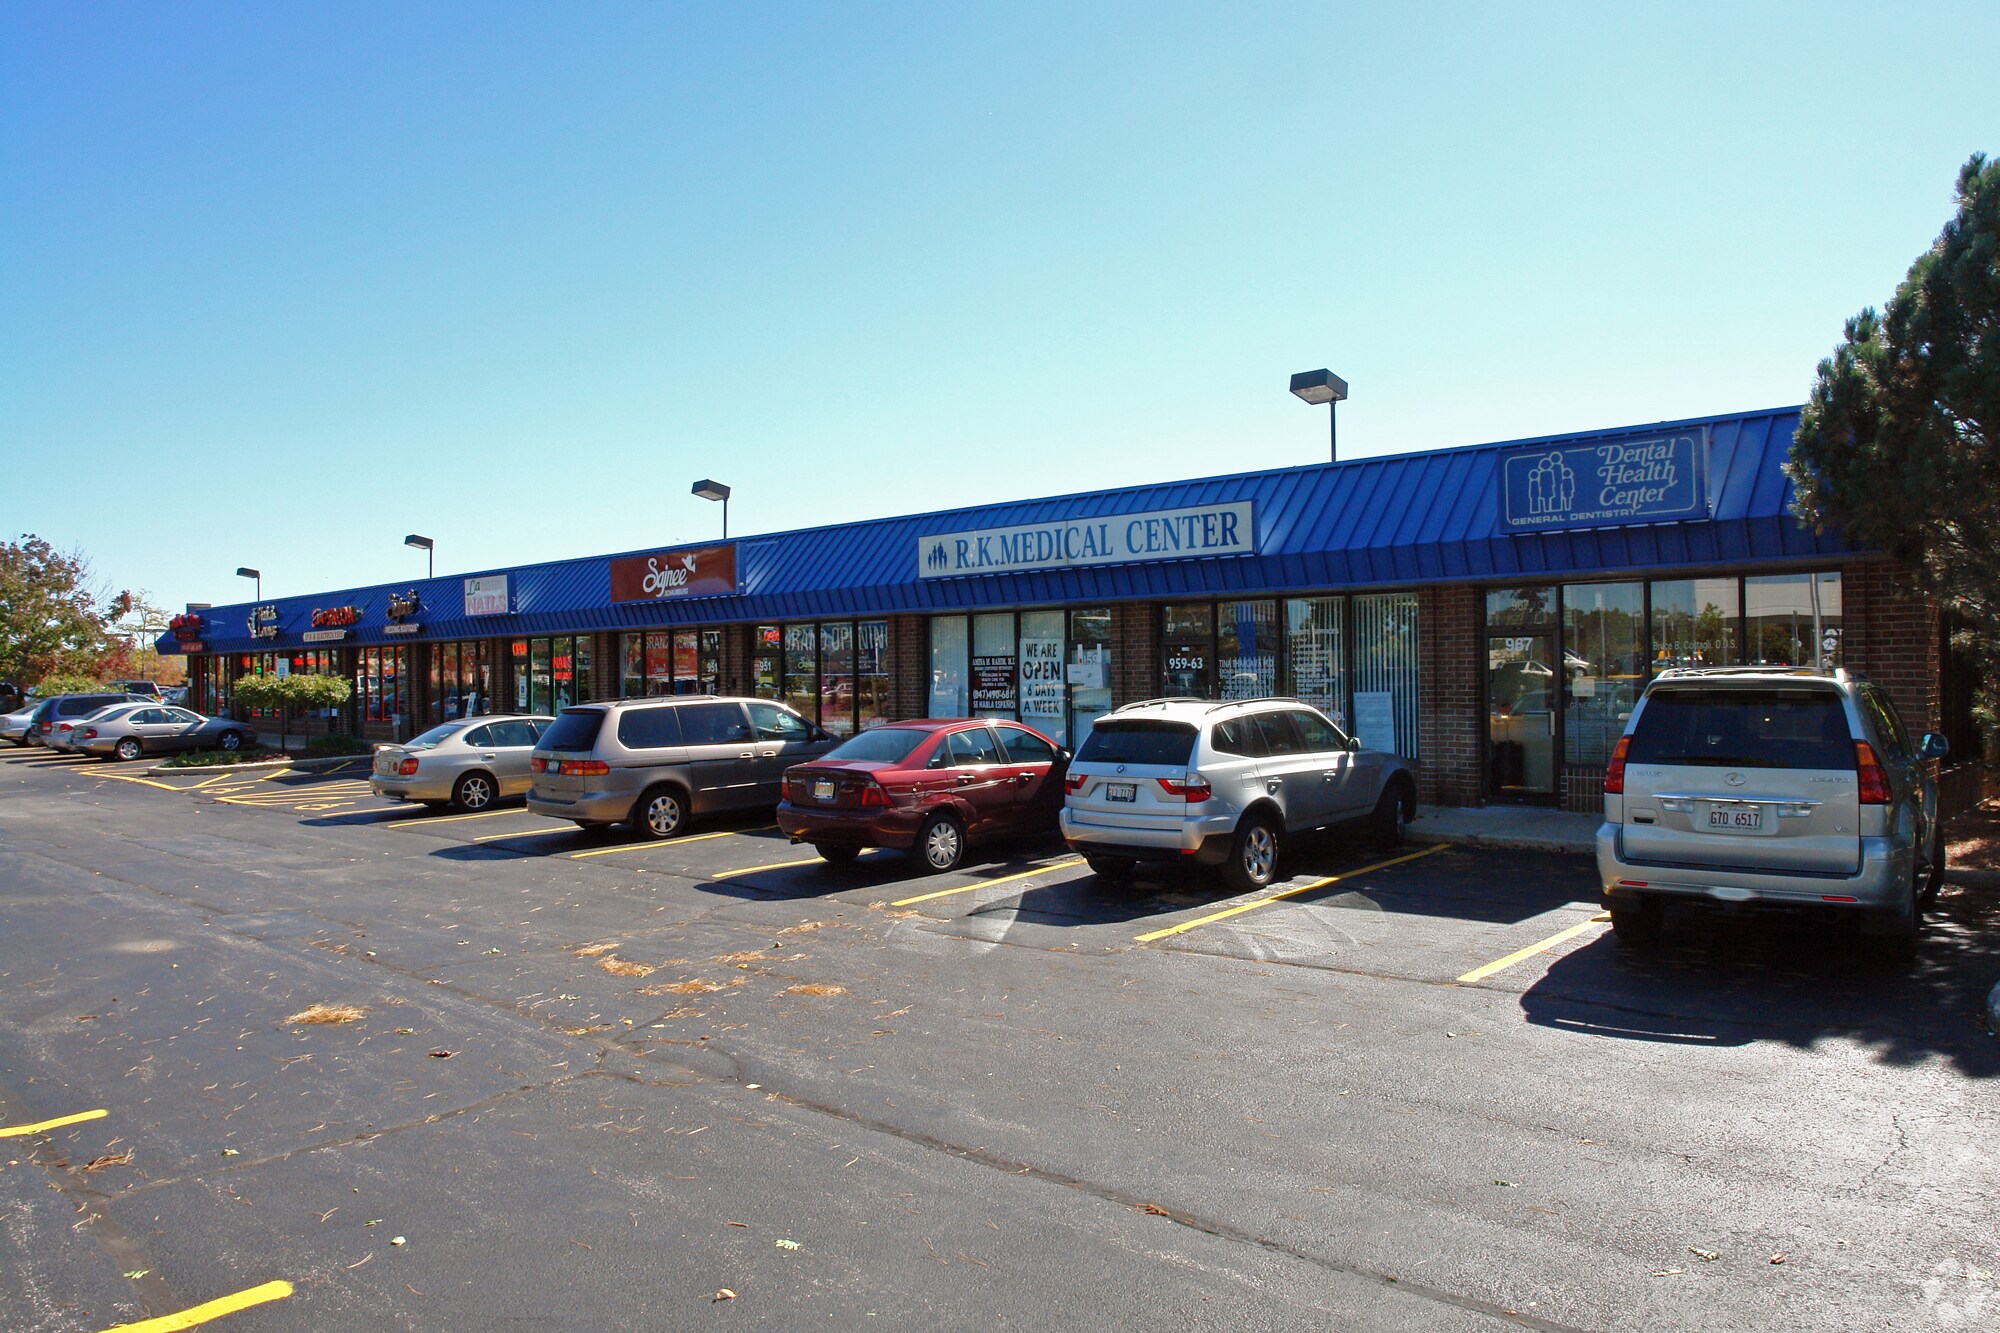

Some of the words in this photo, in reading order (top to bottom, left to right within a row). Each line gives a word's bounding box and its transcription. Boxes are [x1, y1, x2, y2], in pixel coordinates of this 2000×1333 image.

[1597, 438, 1676, 467] Dental
[1597, 459, 1678, 486] Health
[1600, 484, 1668, 510] Center
[1511, 514, 1566, 526] GENERAL
[1570, 509, 1636, 521] DENTISTRY
[1125, 511, 1240, 555] CENTER
[467, 580, 480, 596] La
[467, 594, 507, 614] NAILS
[1511, 599, 1529, 611] 967
[1026, 643, 1038, 658] WE
[1041, 642, 1057, 658] ARE
[1505, 637, 1534, 651] 967
[707, 662, 718, 672] 951
[760, 661, 771, 671] 951
[1023, 661, 1060, 679] OPEN
[1169, 658, 1203, 669] 959-63
[1028, 685, 1032, 696] 6
[1035, 684, 1055, 697] DAYS
[973, 701, 978, 709] SE
[979, 701, 994, 709] HABLA
[995, 700, 1015, 709] ESPAÑO
[1024, 702, 1030, 713] A
[1034, 701, 1060, 713] WEEK
[1711, 811, 1728, 824] G70
[1735, 813, 1759, 826] 6517
